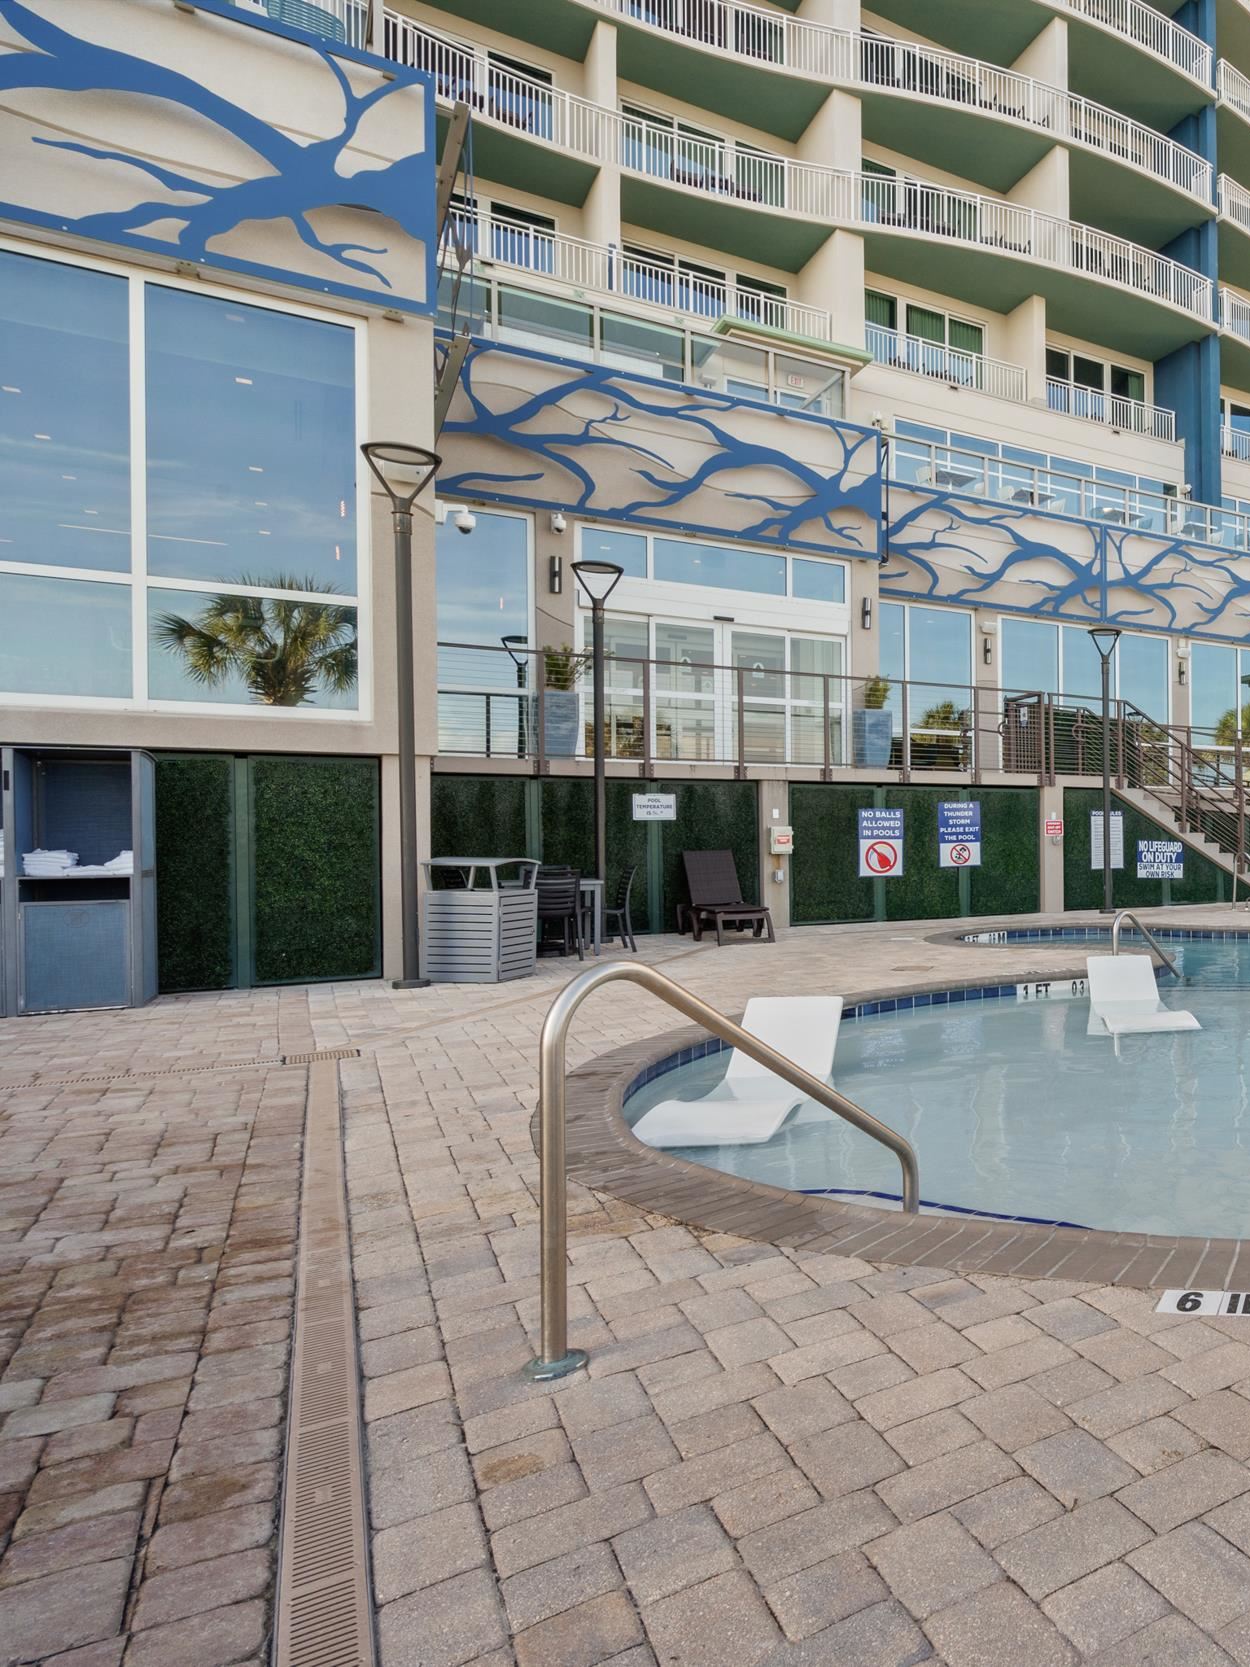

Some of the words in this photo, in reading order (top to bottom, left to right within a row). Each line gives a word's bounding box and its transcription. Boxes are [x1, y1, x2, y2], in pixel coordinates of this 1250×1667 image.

[1138, 840, 1149, 851] NO
[1149, 840, 1183, 853] LIFEGUARD
[1142, 852, 1154, 862] ON
[1155, 852, 1177, 863] DUTY
[1146, 870, 1160, 878] OWN
[1161, 871, 1175, 879] RISK
[1023, 984, 1029, 996] 1
[1035, 982, 1051, 994] FT
[1176, 1292, 1204, 1312] 6
